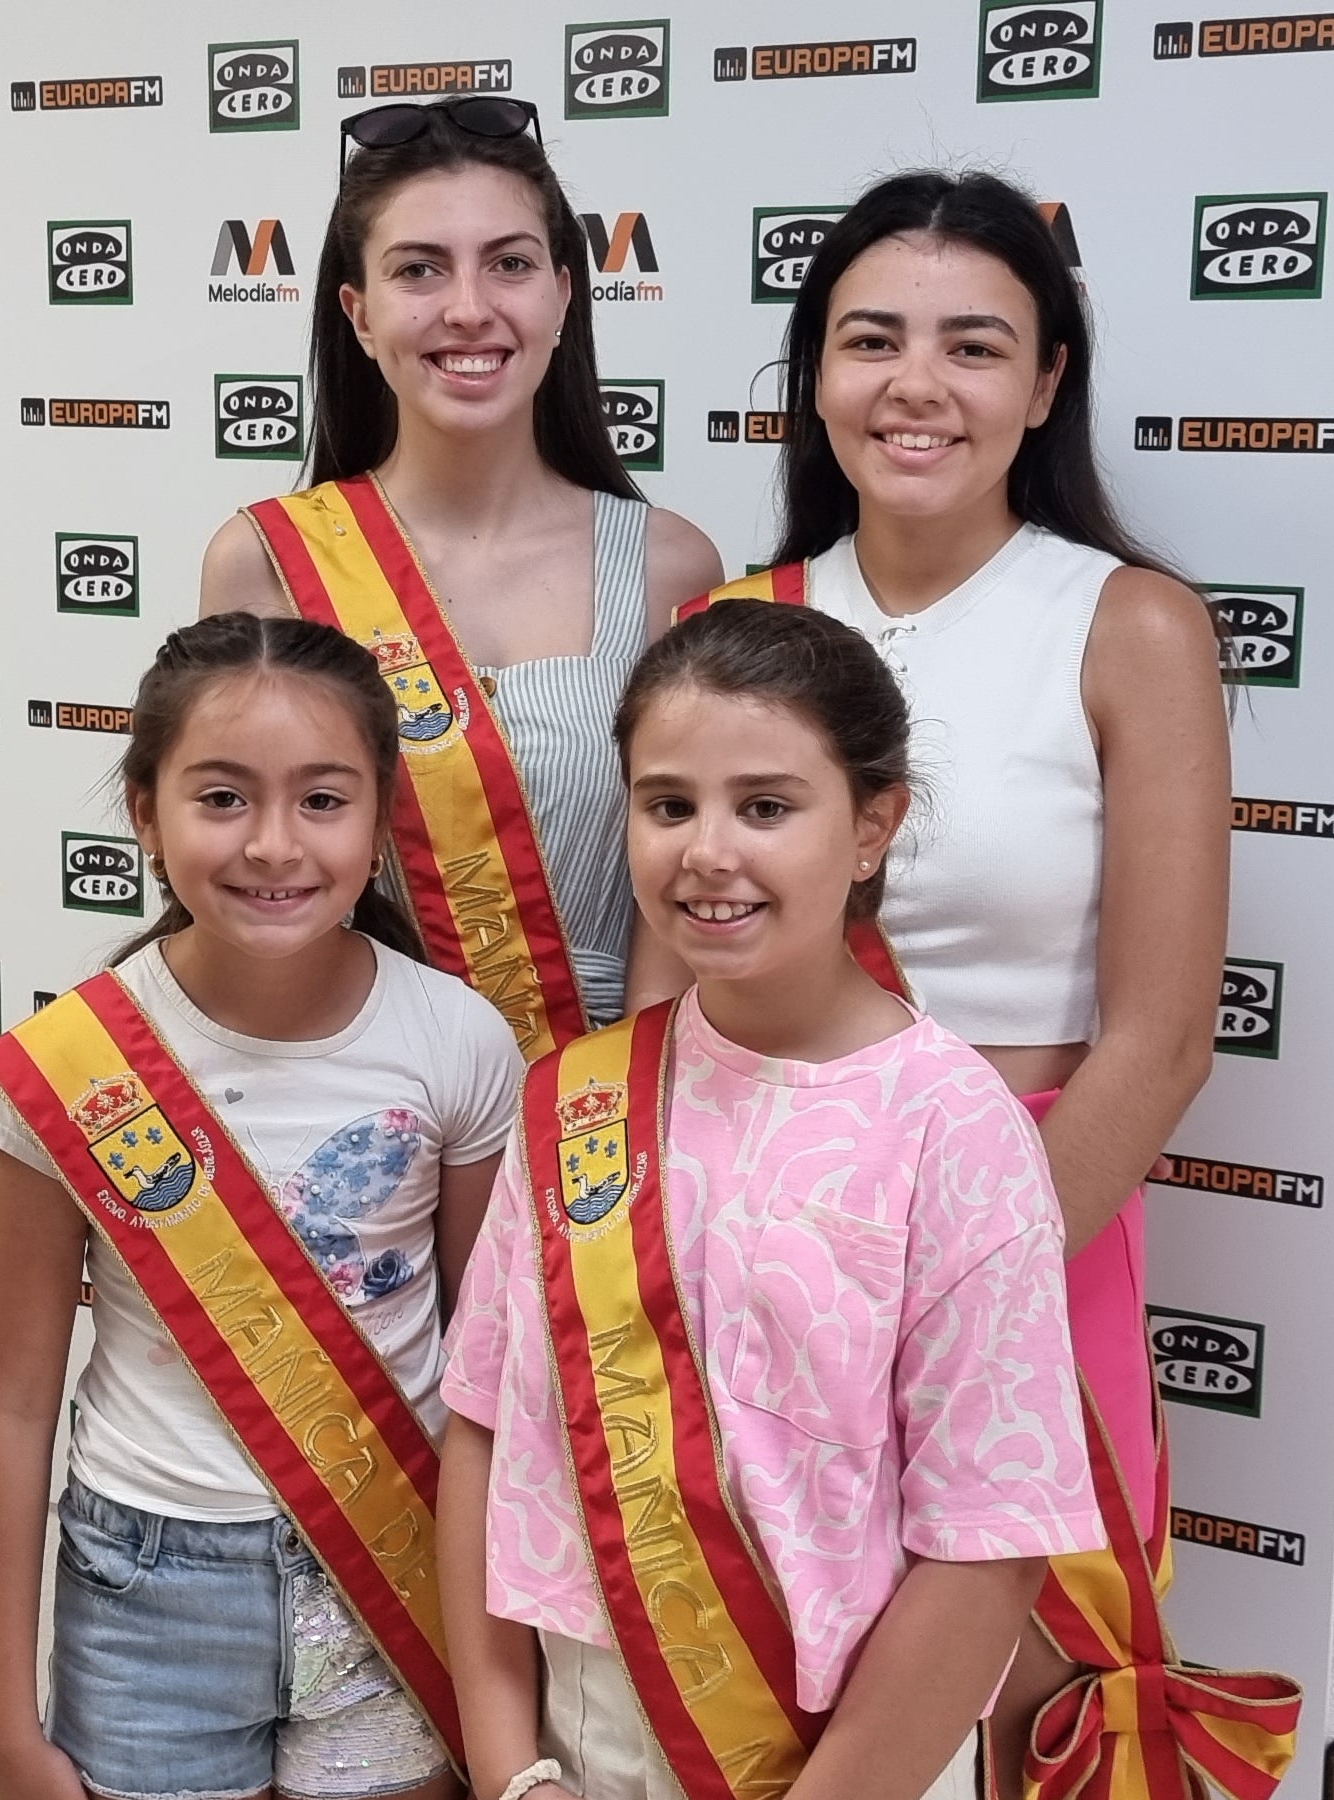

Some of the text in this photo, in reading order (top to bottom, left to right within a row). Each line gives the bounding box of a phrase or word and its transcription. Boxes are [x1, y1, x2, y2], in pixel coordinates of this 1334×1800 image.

[1000, 21, 1078, 42] ONDA
[583, 45, 649, 64] ONDA
[224, 63, 281, 81] ONDA
[1002, 55, 1077, 79] CERO
[586, 77, 649, 98] CERO
[227, 93, 282, 113] CERO
[771, 231, 825, 246] OND
[1216, 220, 1299, 239] ONDA
[62, 242, 115, 256] ONDA
[775, 263, 804, 281] CE
[1218, 254, 1298, 277] CERO
[66, 269, 116, 286] CERO
[592, 281, 663, 301] odíafm
[230, 396, 286, 410] ONDA
[602, 402, 645, 416] NDA
[233, 424, 287, 440] CERO
[617, 432, 644, 449] RO
[70, 553, 123, 567] ONDA
[73, 580, 123, 596] CERO
[1218, 609, 1278, 626] NDA
[1219, 642, 1277, 664] ERO
[59, 706, 134, 732] EUROP
[76, 852, 128, 868] ONDA
[79, 879, 128, 896] CERO
[1224, 982, 1258, 998] DA
[1222, 1014, 1256, 1034] RO
[1169, 1158, 1320, 1204] UROPAFM
[96, 1189, 127, 1222] EXCMO.
[198, 1184, 211, 1198] DE
[1162, 1332, 1239, 1357] ONDA
[186, 1248, 379, 1504] MAÑICA
[1164, 1363, 1238, 1390] CERO
[590, 1321, 735, 1707] MAÑICA
[1174, 1513, 1301, 1561] ROPAFM
